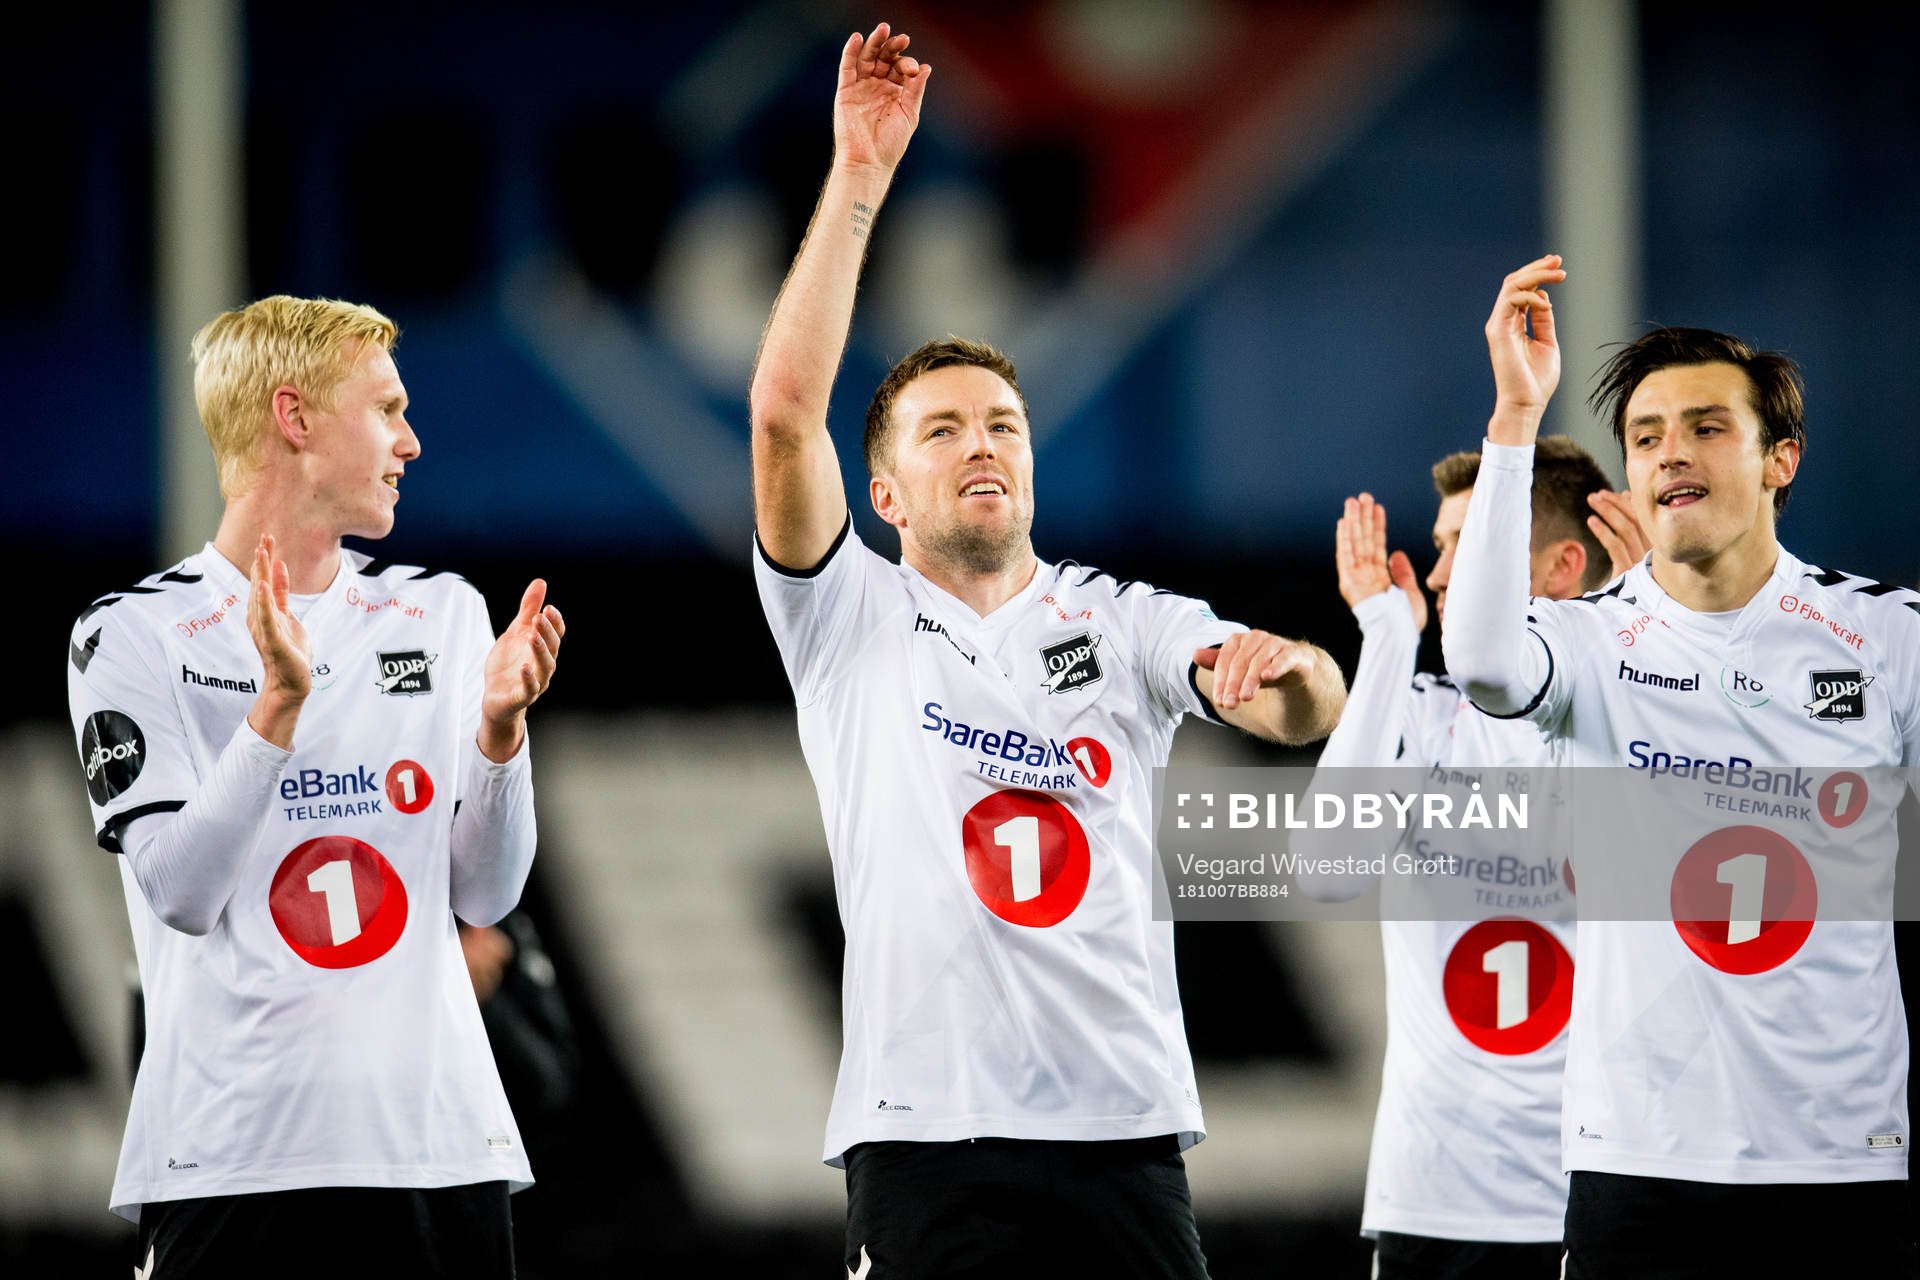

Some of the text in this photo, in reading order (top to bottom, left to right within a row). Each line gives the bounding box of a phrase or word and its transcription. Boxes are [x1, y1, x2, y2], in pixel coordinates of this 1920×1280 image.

[384, 659, 426, 676] ODD
[1048, 645, 1091, 671] ODD
[182, 664, 257, 693] hummel
[400, 680, 421, 689] 1894
[1067, 669, 1088, 683] 1894
[1618, 660, 1700, 692] hummel
[1815, 681, 1860, 697] ODD
[1831, 704, 1852, 713] 1894
[978, 760, 1078, 790] TELEMARK
[1628, 740, 1814, 800] SpareBank
[284, 799, 383, 822] TELEMARK
[1703, 791, 1812, 822] TELEMARK
[994, 816, 1042, 903] 1
[307, 859, 362, 946] 1
[1715, 853, 1768, 945] 1
[1483, 941, 1529, 1030] 1
